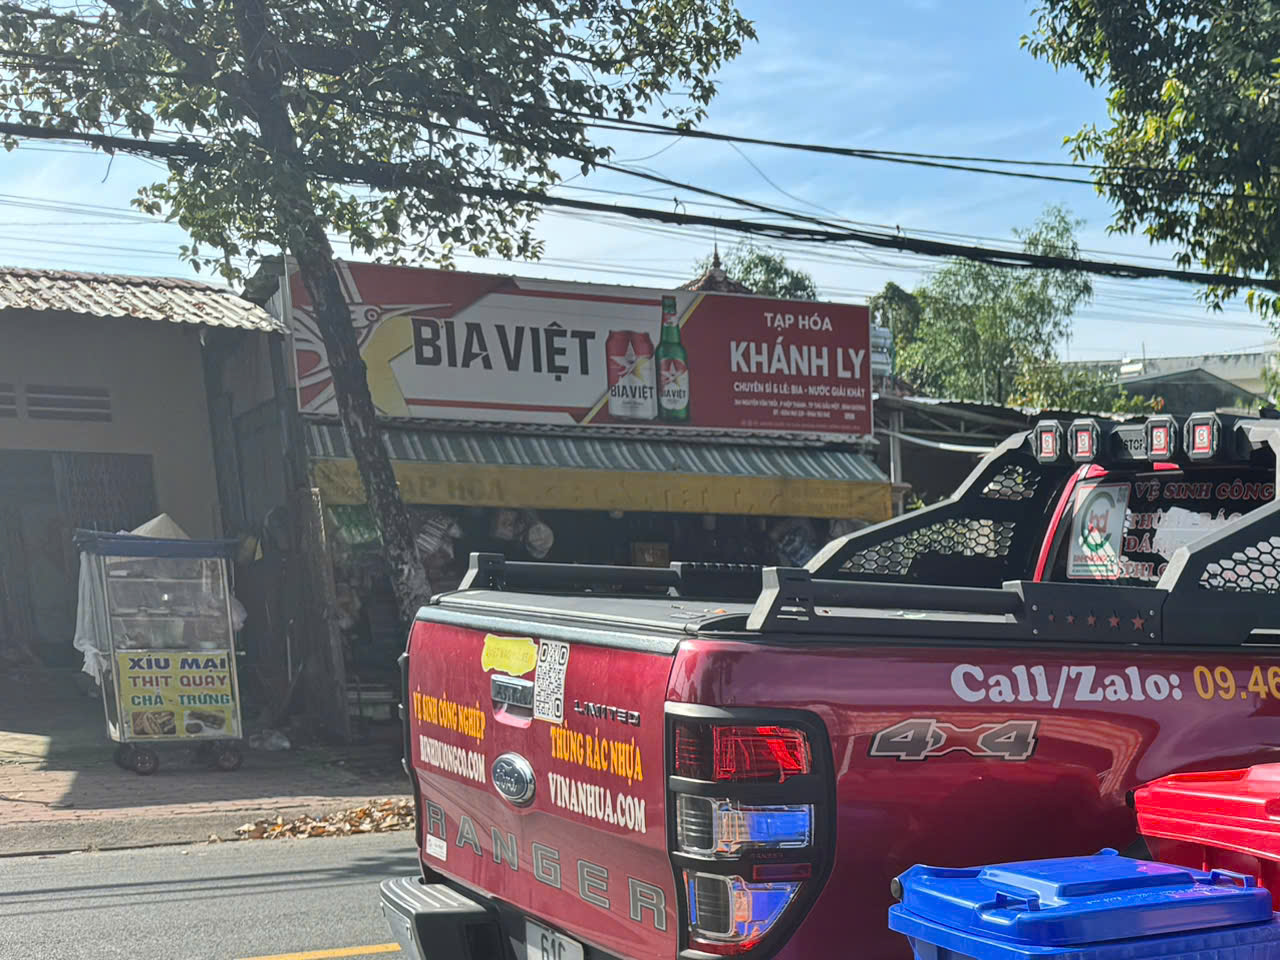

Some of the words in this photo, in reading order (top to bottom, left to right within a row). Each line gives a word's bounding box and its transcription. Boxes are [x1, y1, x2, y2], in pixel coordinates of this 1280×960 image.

[764, 312, 794, 331] TẠP
[798, 313, 832, 331] HÓA
[730, 336, 828, 377] KHÁNH
[837, 347, 865, 379] LY
[734, 381, 764, 393] CHUYÊN
[1135, 478, 1160, 501] VỆ
[1163, 483, 1212, 500] SINH
[1216, 478, 1275, 500] CÔNG
[180, 657, 226, 673] MẠI
[950, 664, 1183, 708] Call/Zalo:
[574, 699, 641, 727] LIMITED
[550, 719, 584, 765] THÙNG
[585, 727, 609, 771] RÁC
[610, 736, 643, 787] NHỰA
[548, 772, 647, 833] VINANHUA.COM
[424, 799, 668, 932] RANGER
